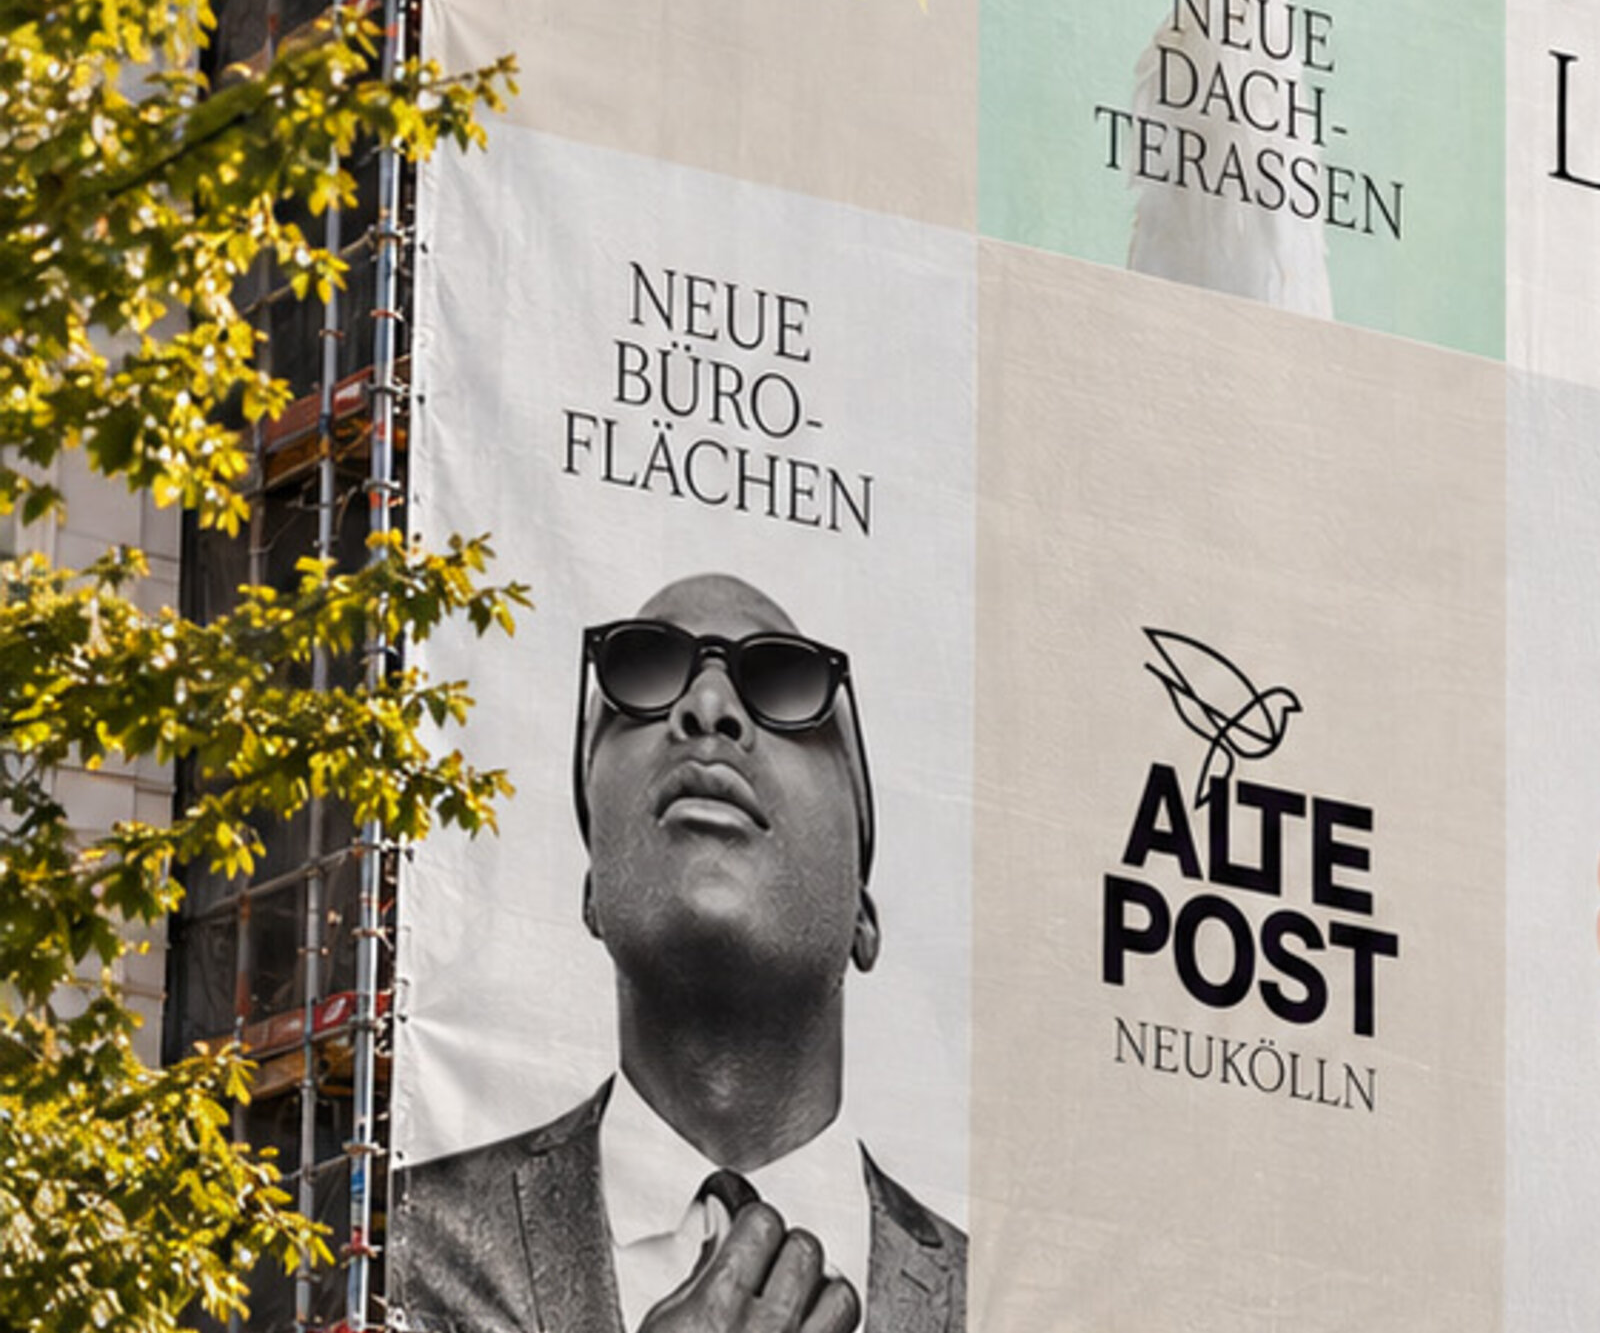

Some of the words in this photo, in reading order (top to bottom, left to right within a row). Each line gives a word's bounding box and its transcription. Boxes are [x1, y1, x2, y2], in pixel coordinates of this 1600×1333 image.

[1156, 45, 1348, 147] DACH-
[1095, 105, 1405, 240] TERASSEN
[629, 261, 812, 363] NEUE
[613, 339, 823, 439] BÜRO-
[561, 409, 874, 537] FLÄCHEN
[1123, 762, 1374, 916] ALTE
[1102, 873, 1399, 1038] POST
[1114, 1017, 1377, 1113] NEUKÖLLN
